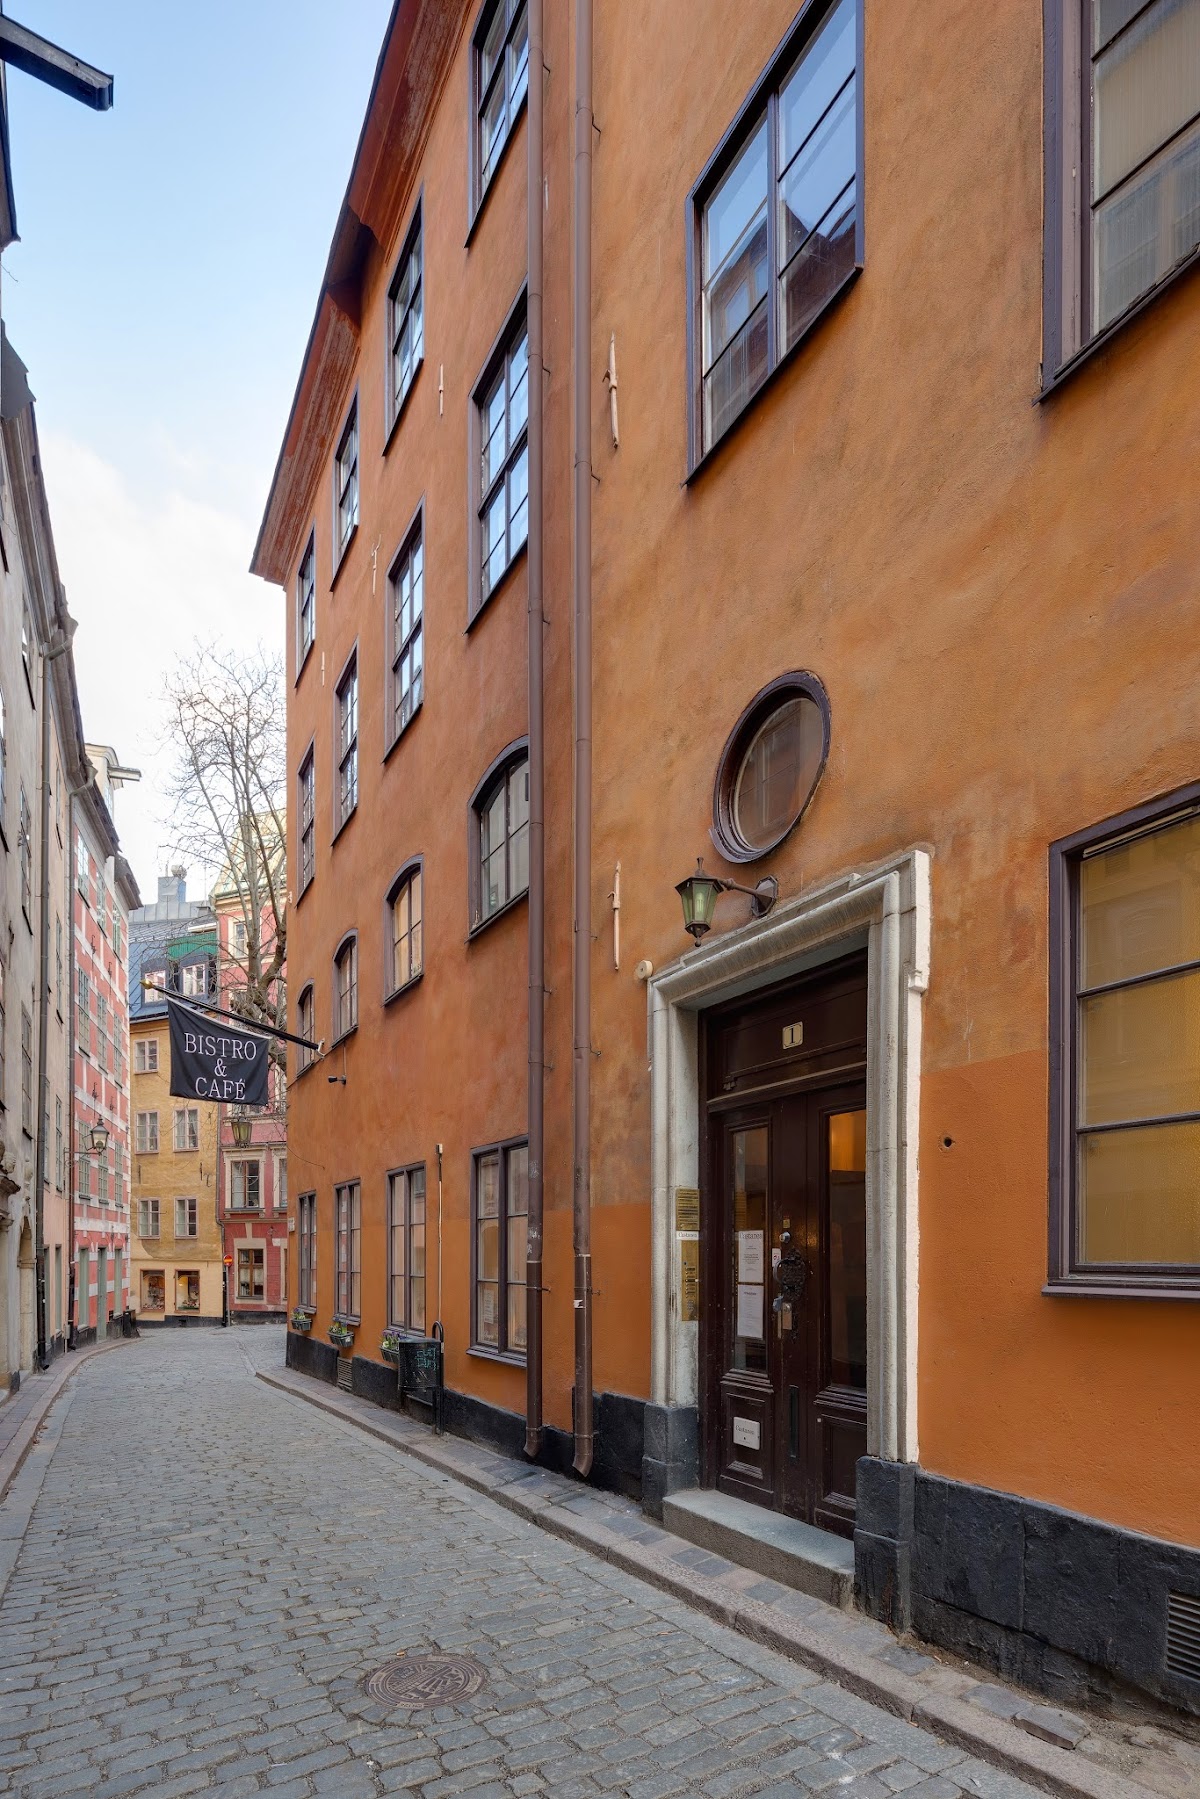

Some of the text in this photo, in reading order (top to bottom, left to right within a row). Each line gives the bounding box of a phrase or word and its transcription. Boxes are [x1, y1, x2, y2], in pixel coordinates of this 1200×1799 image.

[789, 1026, 796, 1044] 1
[184, 1032, 257, 1061] BISTRO
[214, 1058, 228, 1077] &
[195, 1077, 246, 1100] CAFÉ
